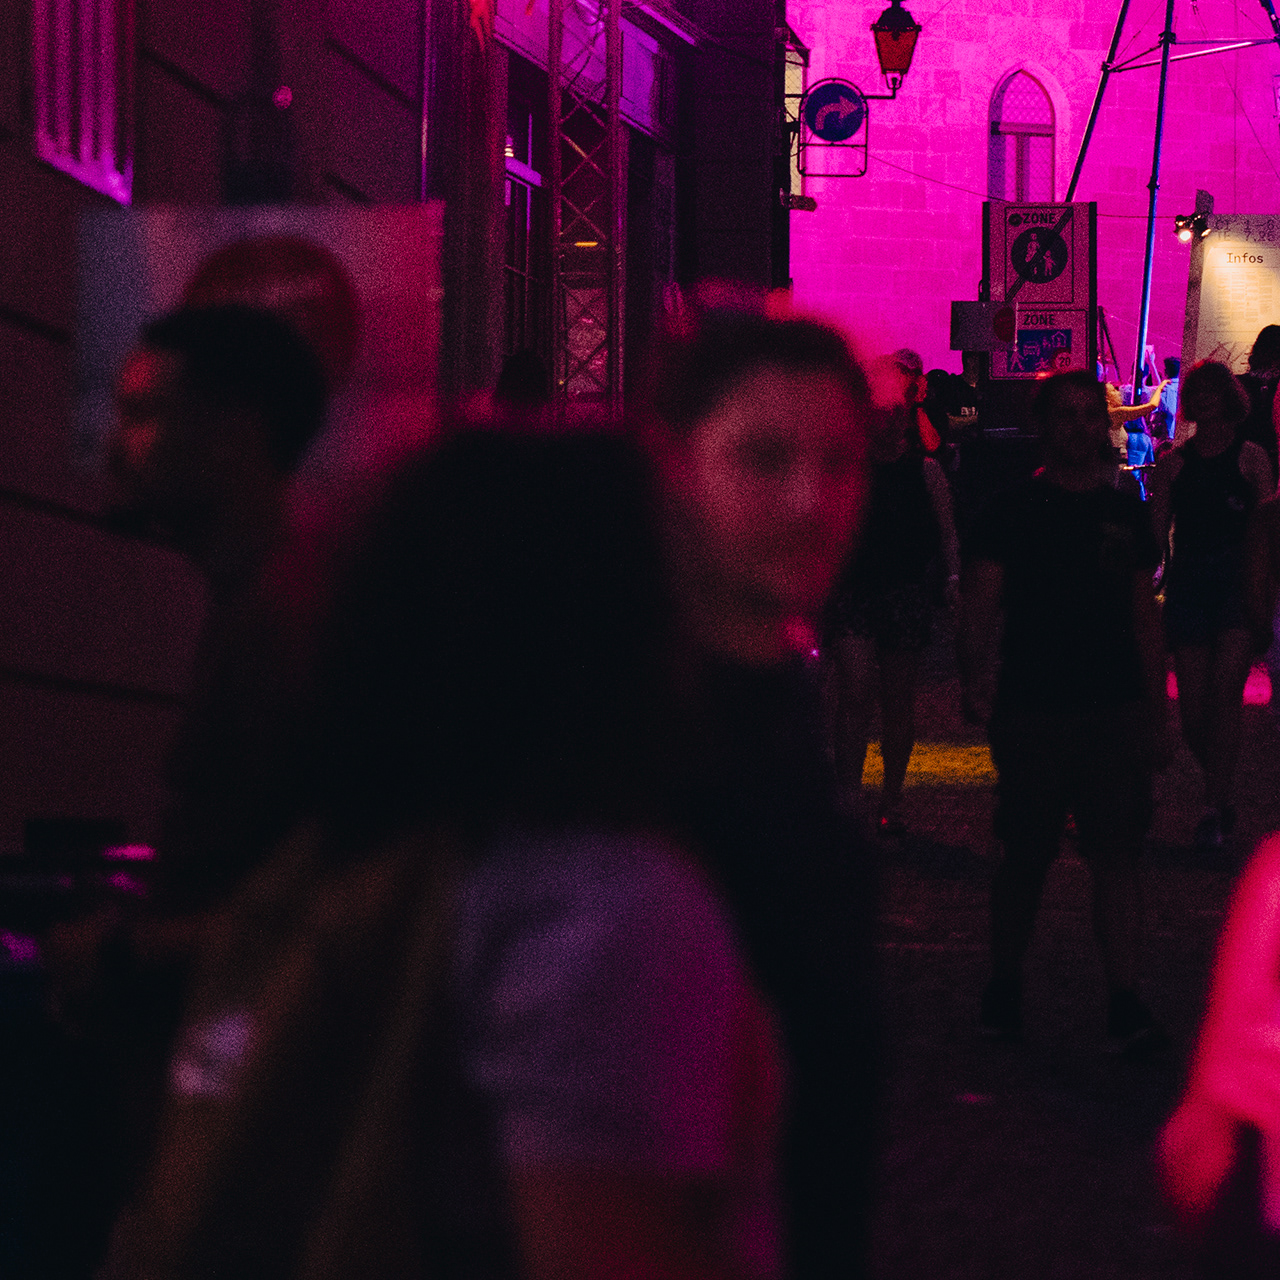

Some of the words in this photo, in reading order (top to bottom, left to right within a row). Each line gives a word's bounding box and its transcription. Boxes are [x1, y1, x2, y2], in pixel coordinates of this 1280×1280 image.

[1022, 213, 1056, 224] ZONE
[1226, 252, 1264, 264] Infos
[1023, 314, 1055, 326] ZONE
